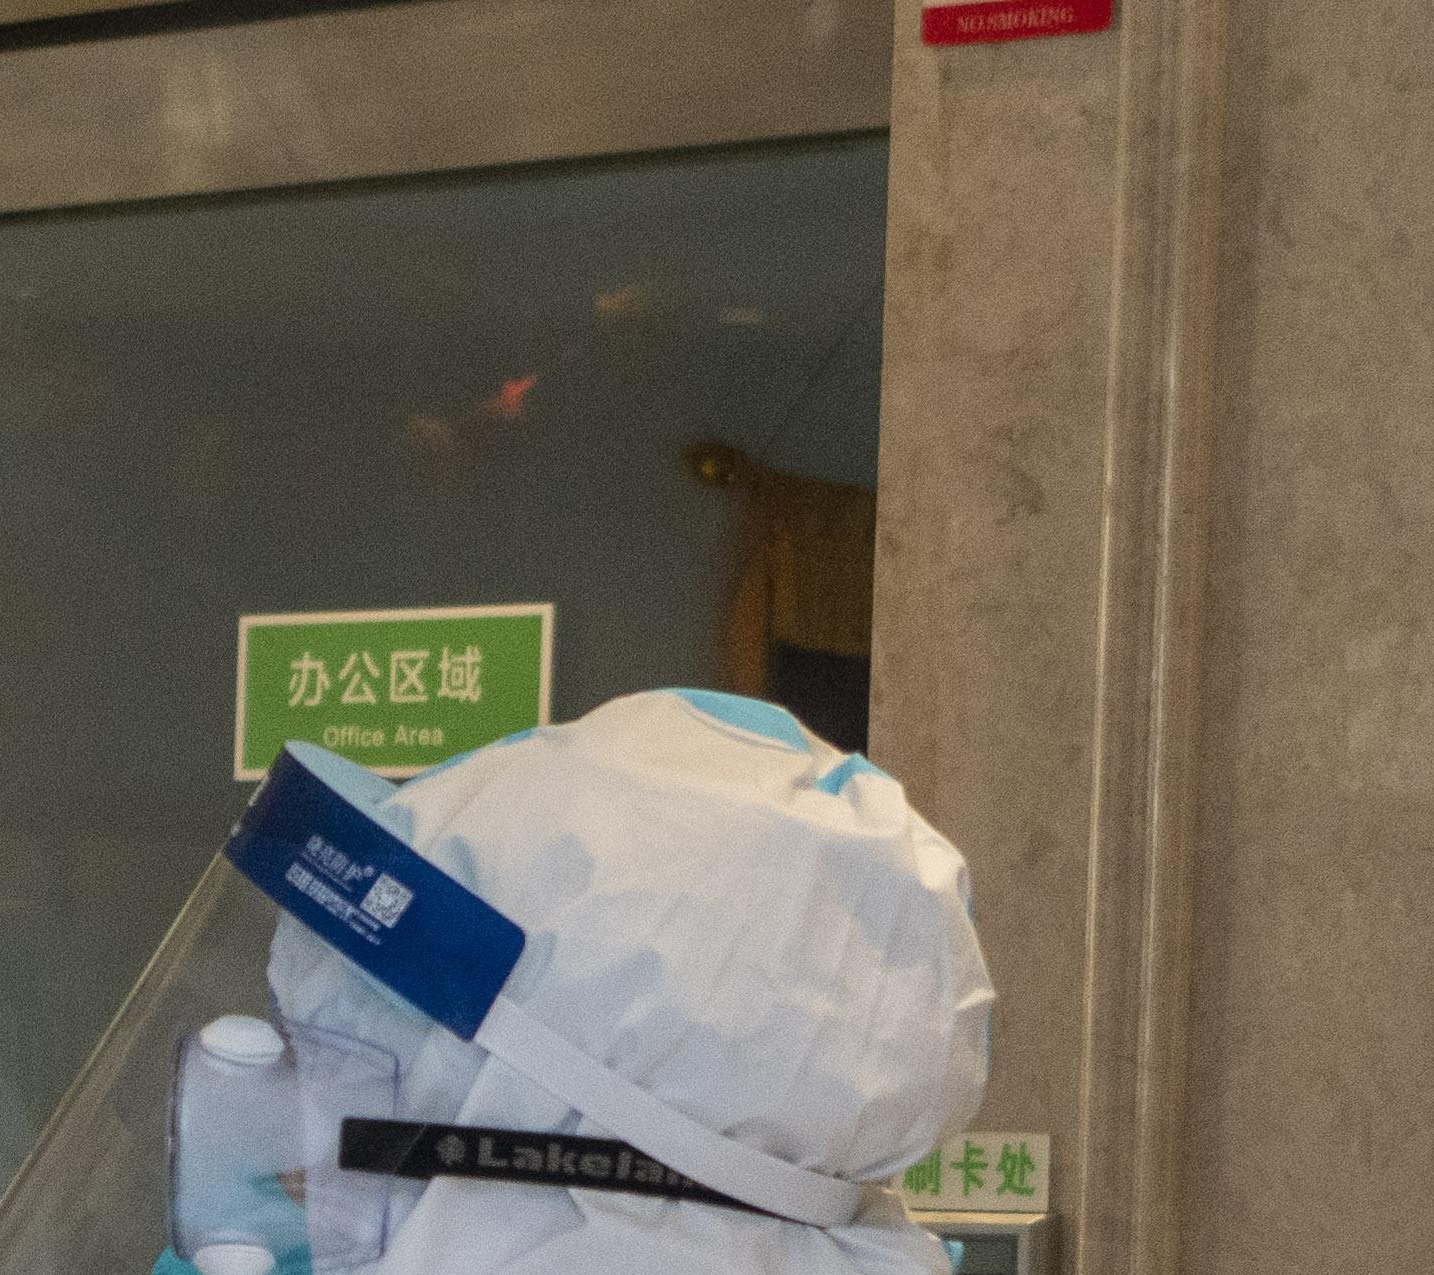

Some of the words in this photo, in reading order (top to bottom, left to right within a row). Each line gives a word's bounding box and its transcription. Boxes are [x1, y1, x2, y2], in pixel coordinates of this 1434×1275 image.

[985, 6, 1075, 31] SMOKING
[288, 646, 482, 707] 办公区域
[323, 725, 385, 747] Office
[393, 724, 444, 746] Area
